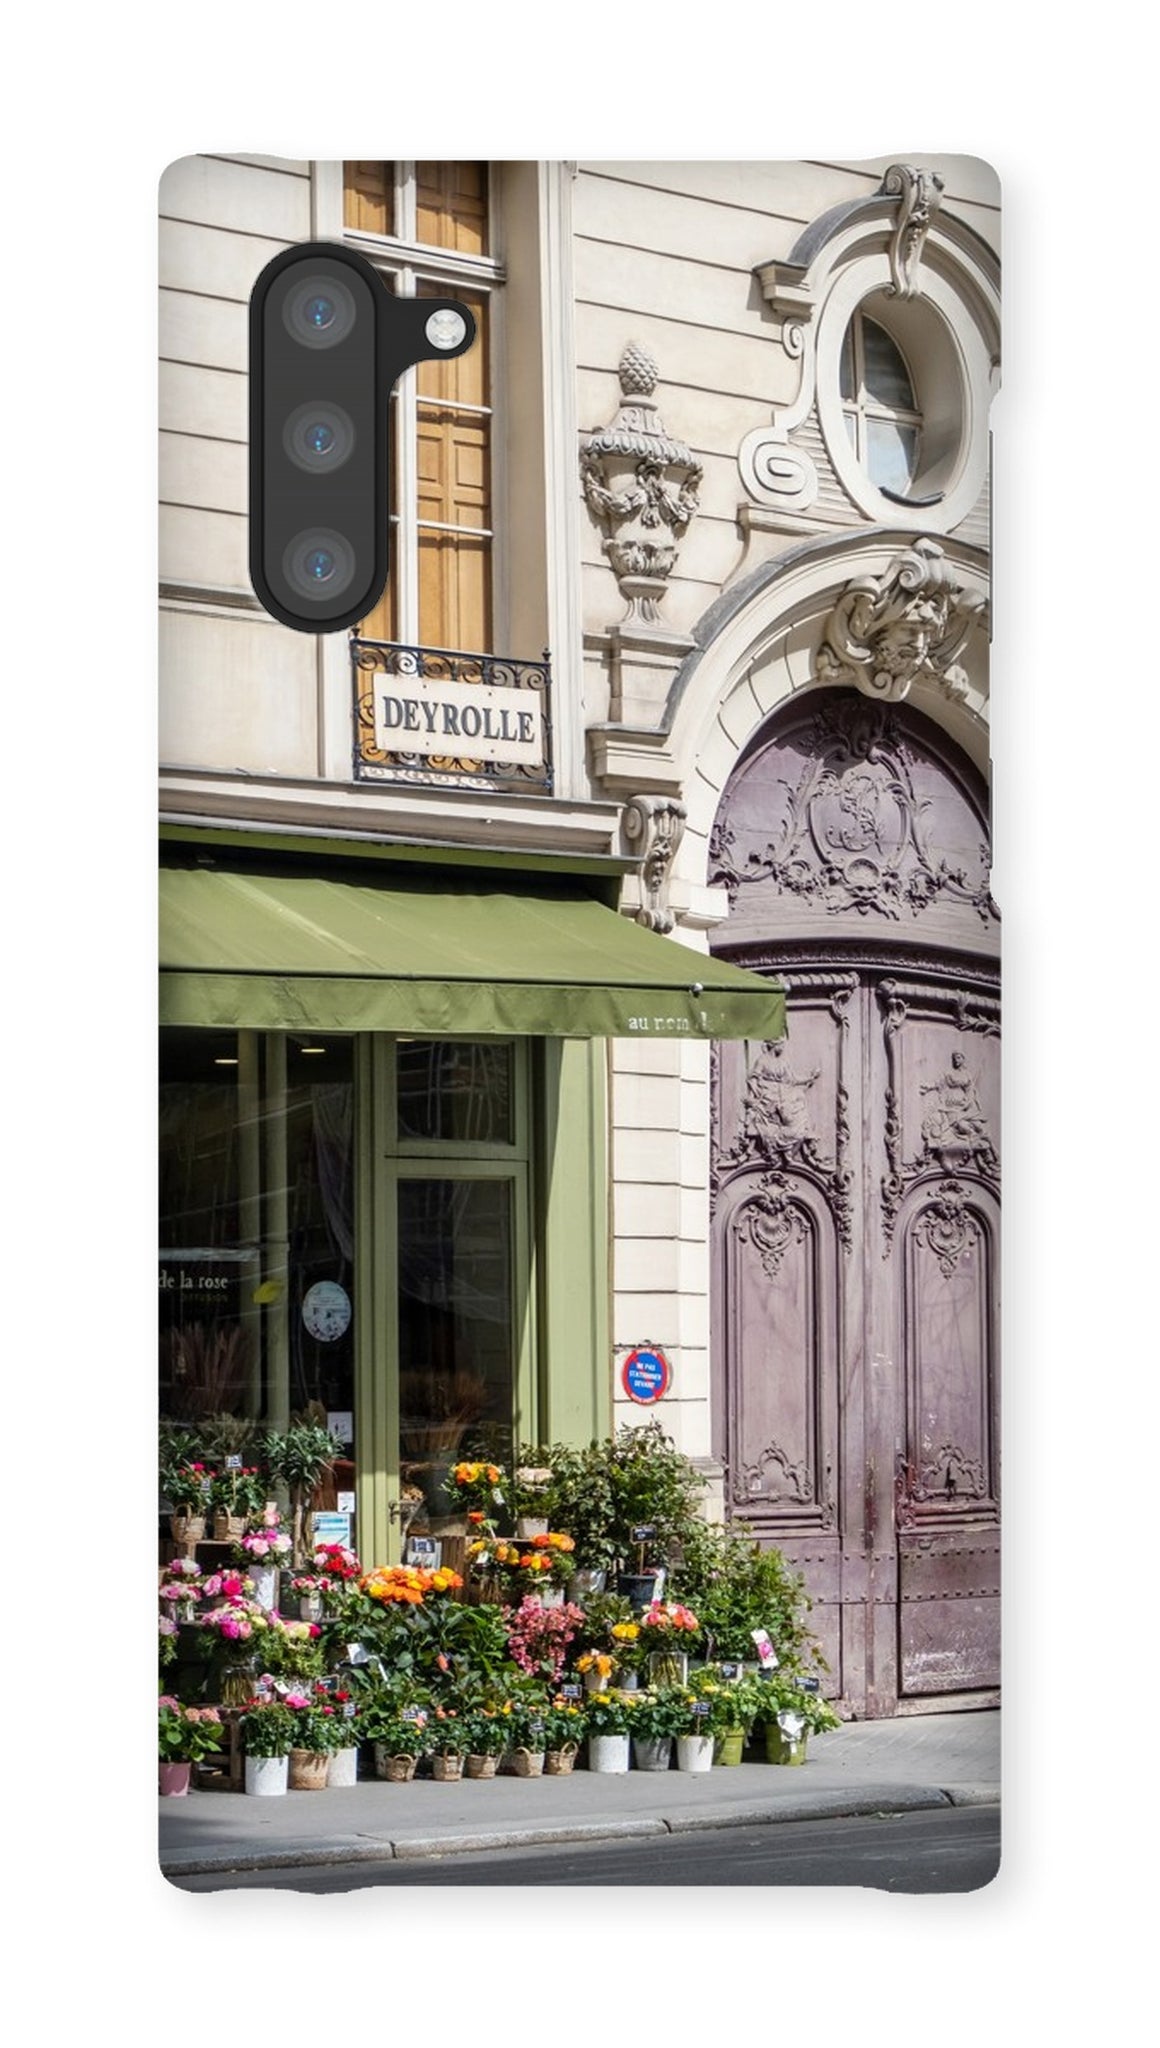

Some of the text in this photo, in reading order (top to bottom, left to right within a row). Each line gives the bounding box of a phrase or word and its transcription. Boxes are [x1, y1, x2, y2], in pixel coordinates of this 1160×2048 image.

[382, 696, 535, 743] DEYROLLE
[628, 1016, 649, 1031] au
[159, 1269, 229, 1289] de la rose
